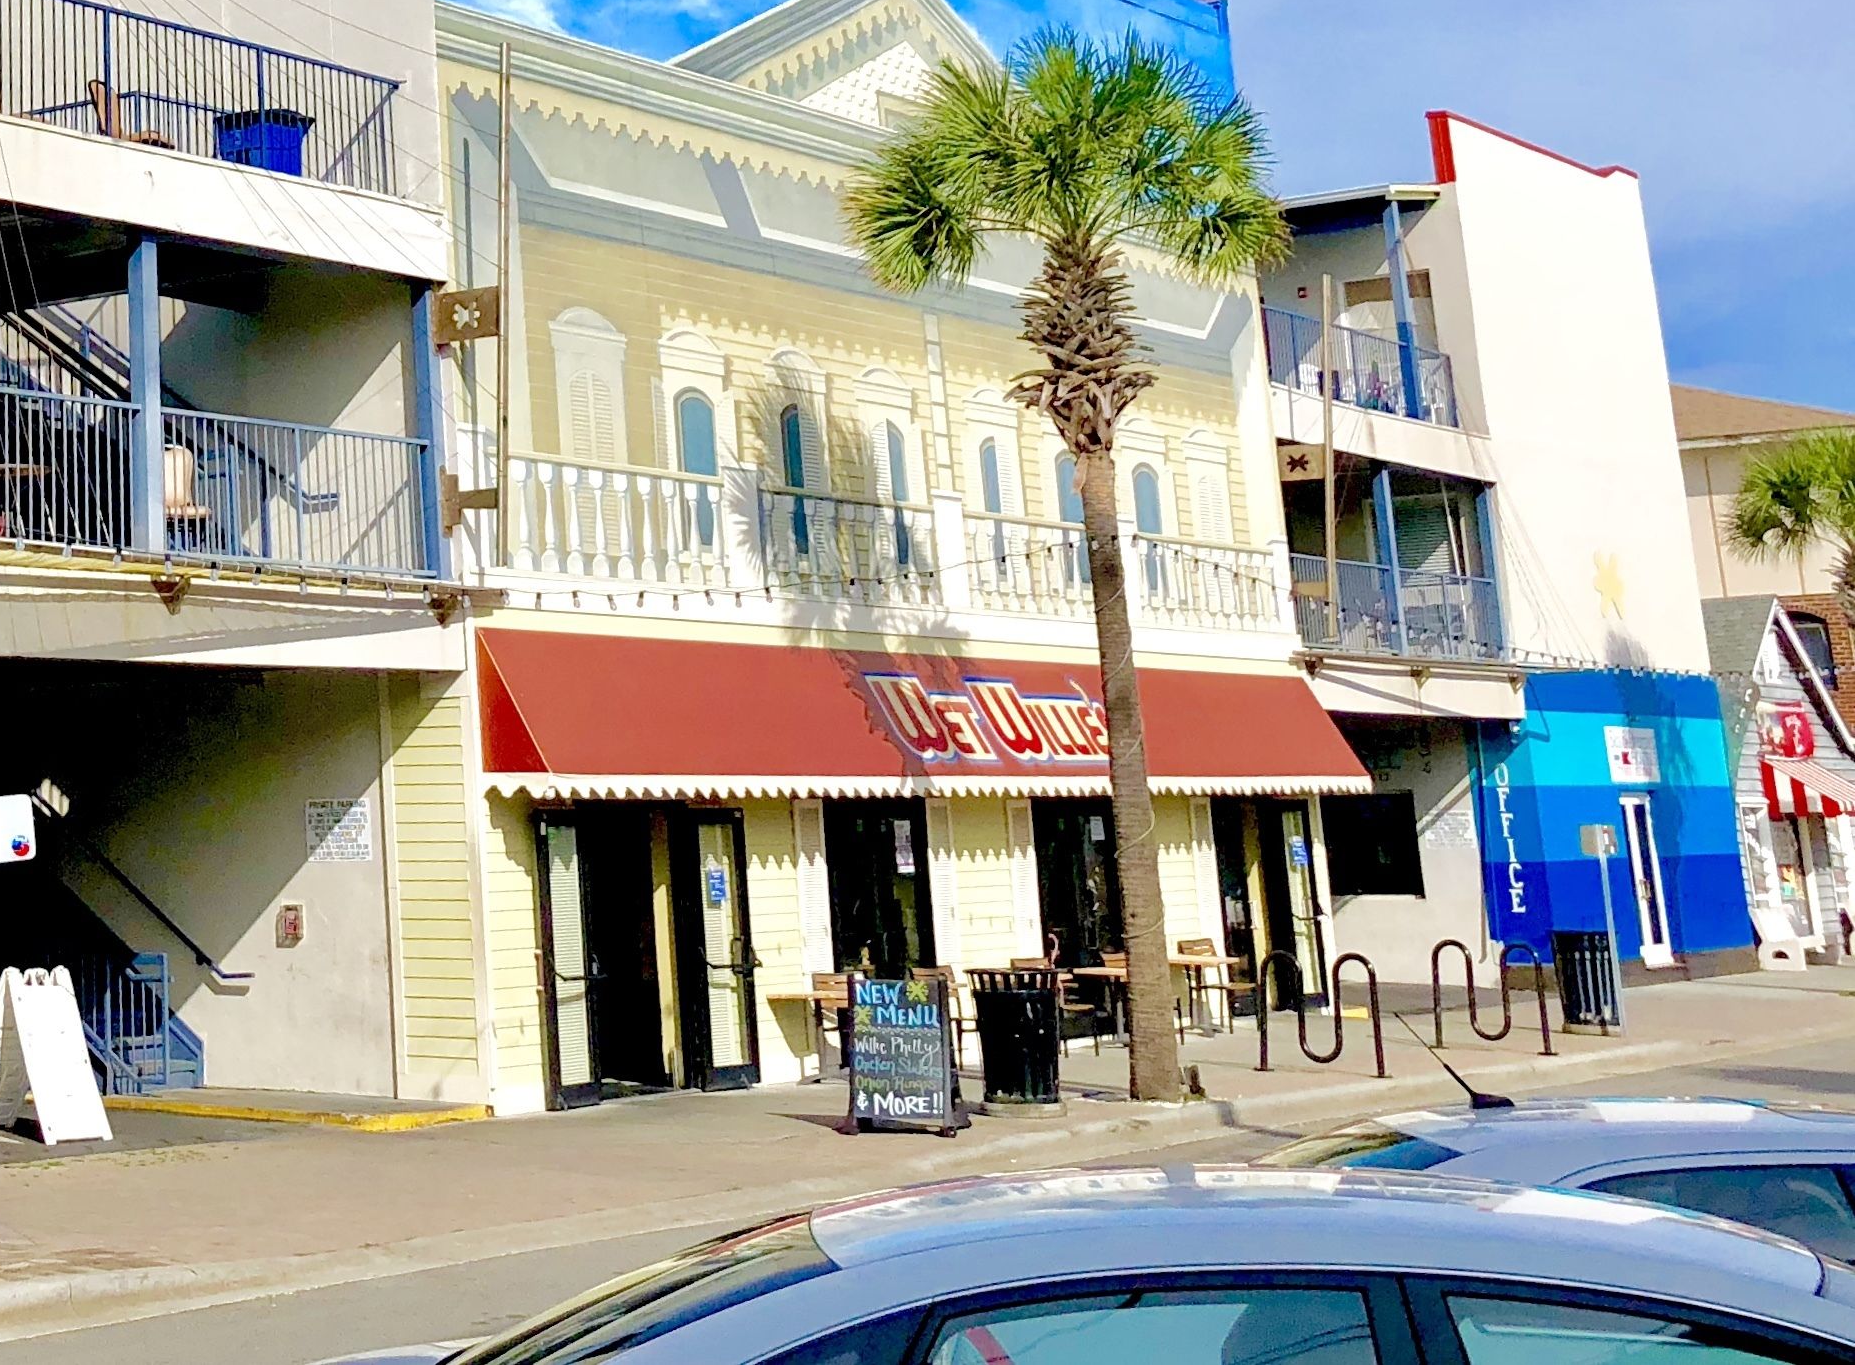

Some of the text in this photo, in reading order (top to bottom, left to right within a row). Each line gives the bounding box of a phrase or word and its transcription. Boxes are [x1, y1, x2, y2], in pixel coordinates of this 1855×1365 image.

[1495, 762, 1526, 913] OFFICE
[856, 980, 903, 1005] NEW
[877, 1004, 940, 1027] MENU
[891, 1037, 940, 1066] Philly
[873, 1091, 944, 1116] MORE!!
